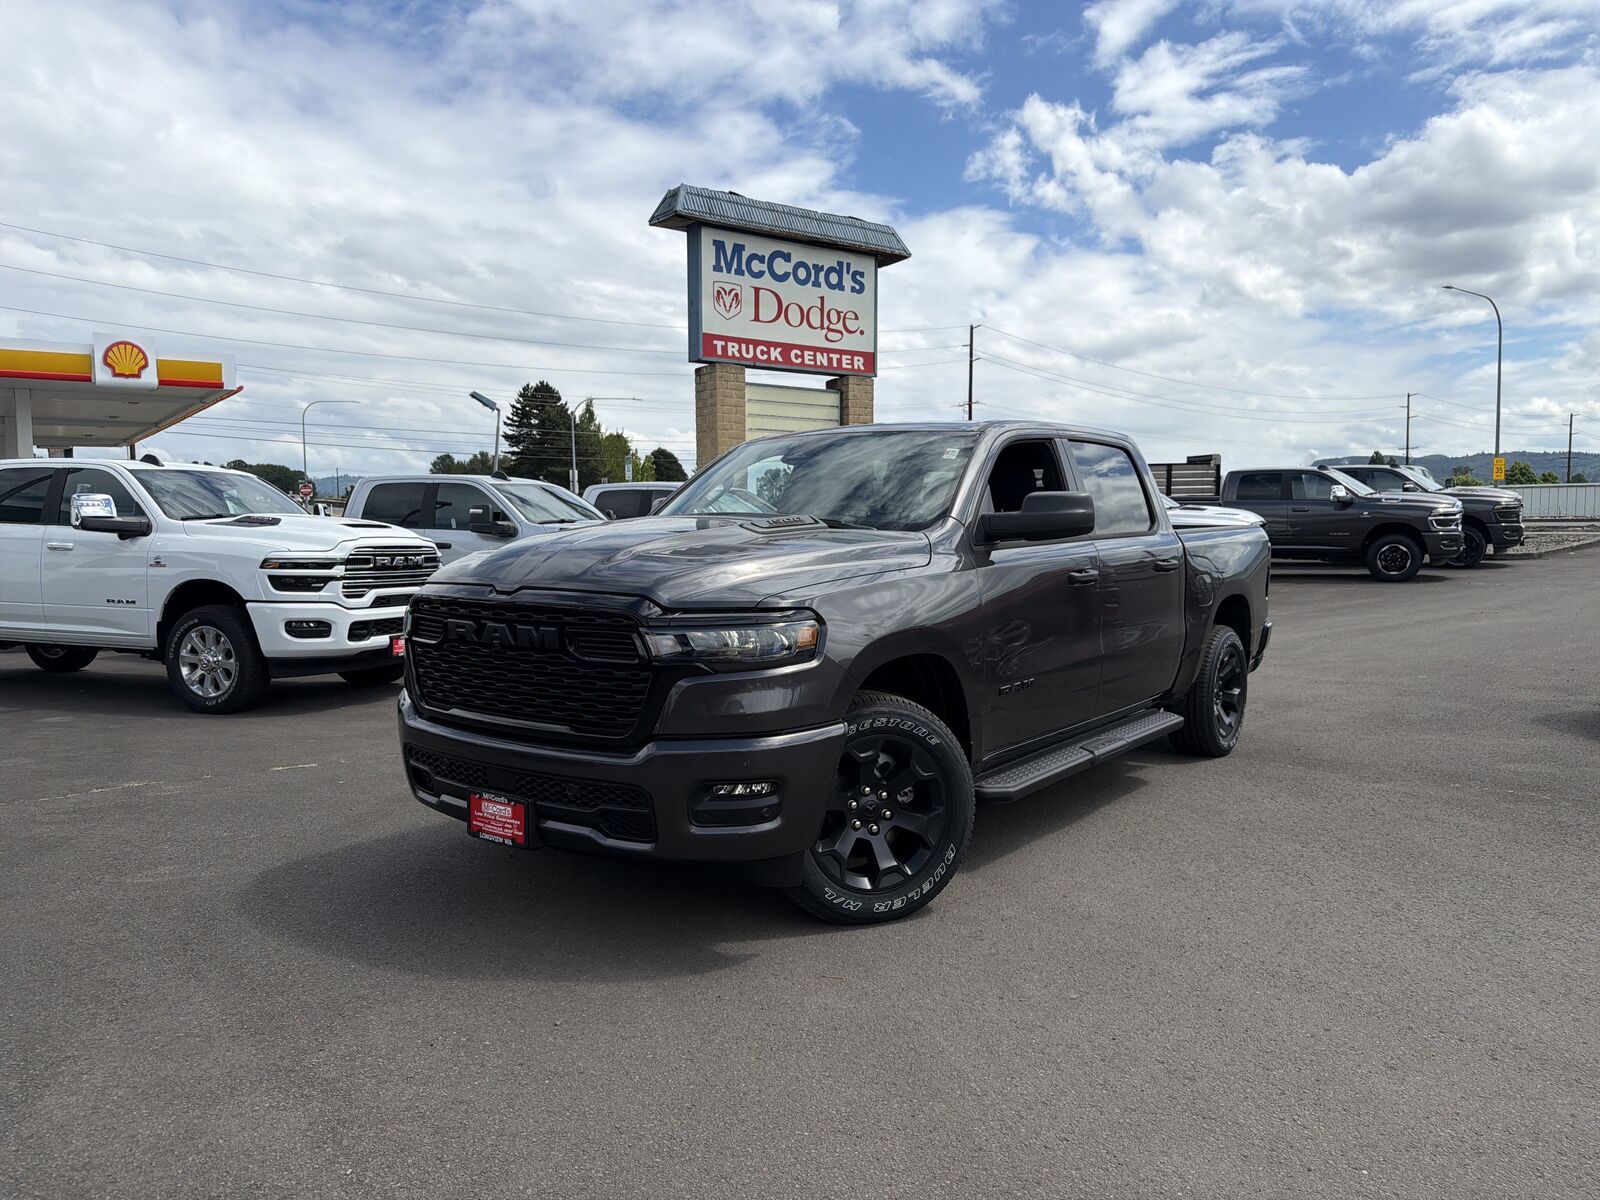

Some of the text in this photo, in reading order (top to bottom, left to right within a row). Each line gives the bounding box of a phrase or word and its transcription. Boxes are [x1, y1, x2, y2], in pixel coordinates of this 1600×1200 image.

[712, 239, 866, 295] McCord's
[713, 340, 865, 371] TRUCK CENTER
[375, 556, 422, 567] RAM
[447, 619, 558, 649] RAM
[824, 844, 957, 912] DUELER H/L
